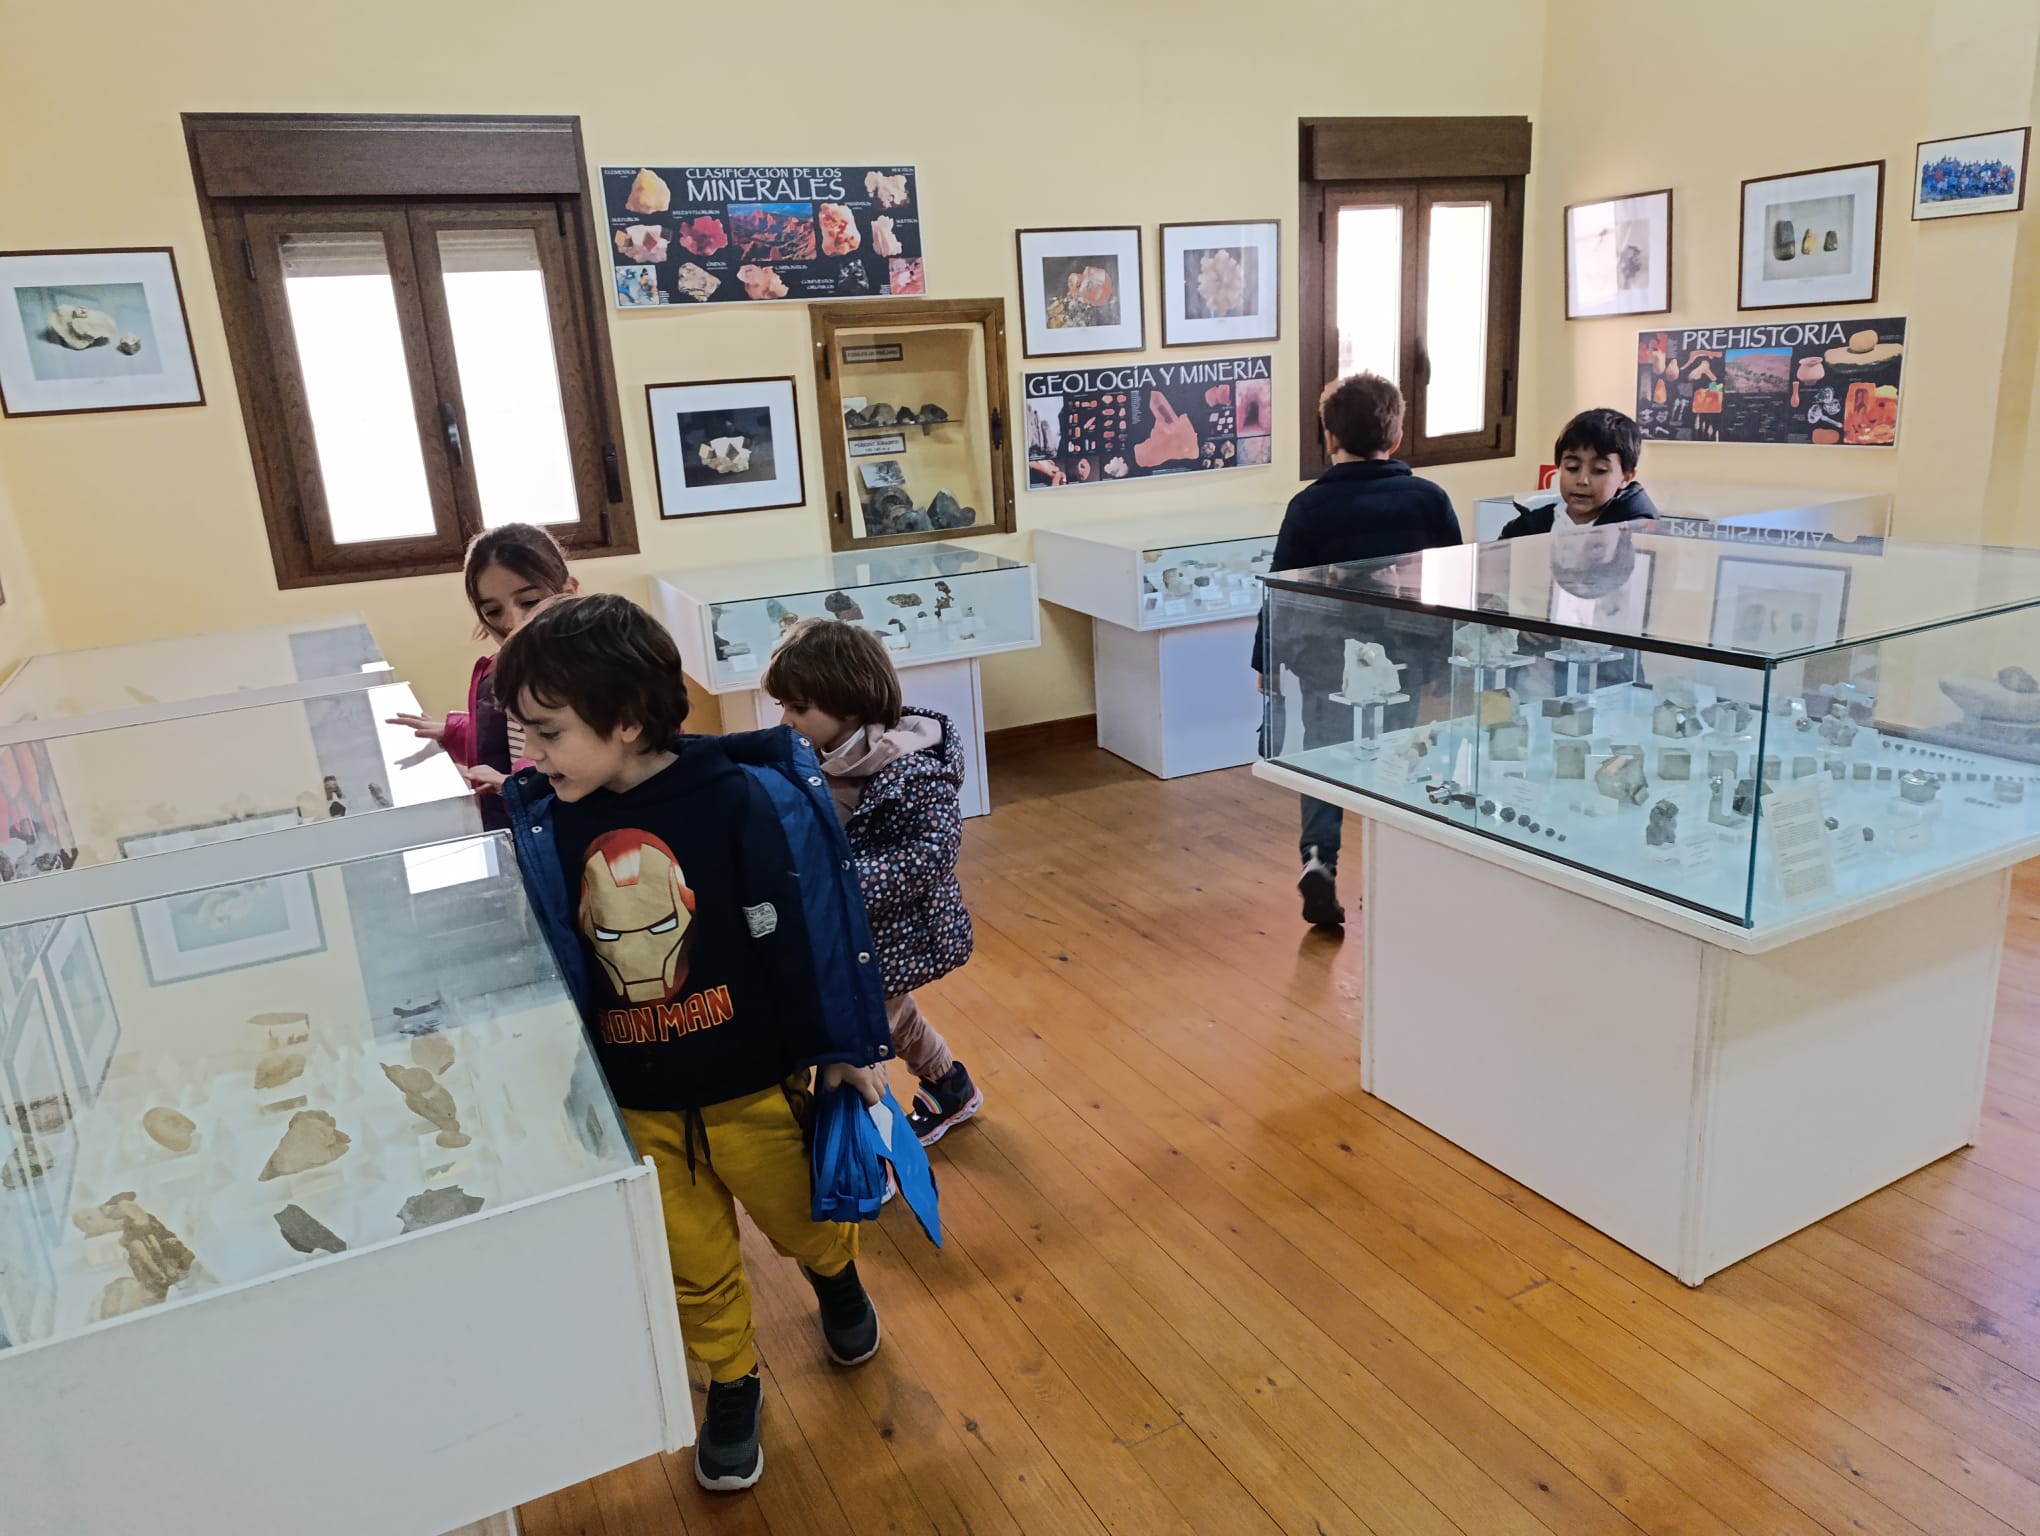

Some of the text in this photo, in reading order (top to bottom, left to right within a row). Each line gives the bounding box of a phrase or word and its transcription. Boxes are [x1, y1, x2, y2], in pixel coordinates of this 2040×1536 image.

[793, 168, 812, 178] DE
[816, 168, 842, 178] LOS
[686, 178, 846, 202] MINERALES
[1682, 322, 1847, 351] PREHISTORIA
[1028, 355, 1269, 396] GEOLOGÍA Y MINERÍA
[598, 984, 735, 1044] RON MAN
